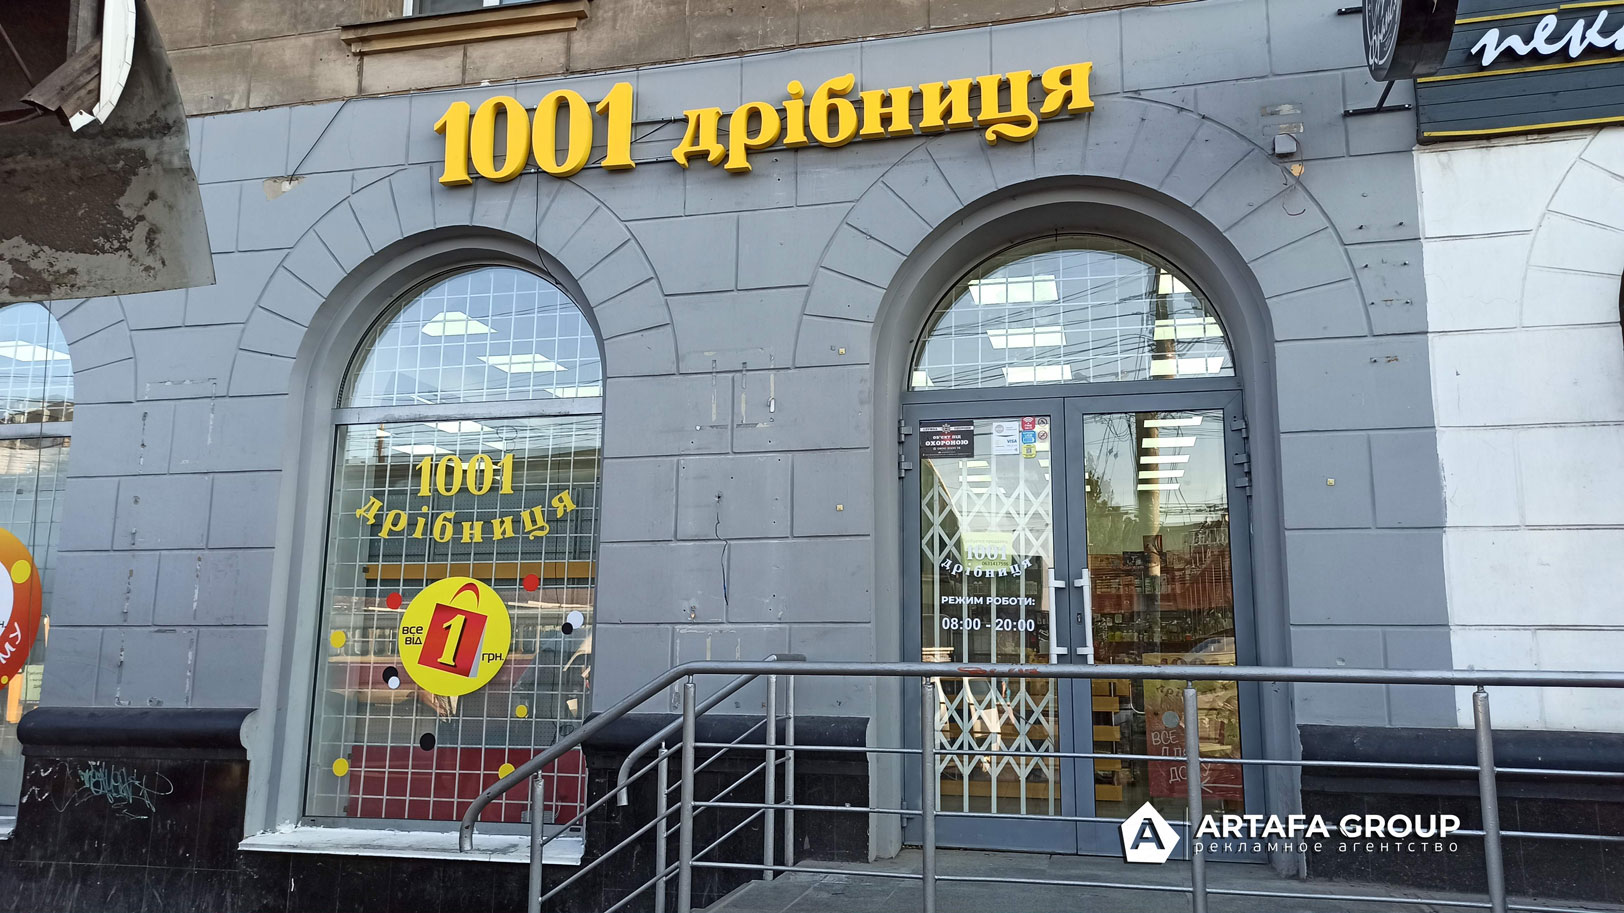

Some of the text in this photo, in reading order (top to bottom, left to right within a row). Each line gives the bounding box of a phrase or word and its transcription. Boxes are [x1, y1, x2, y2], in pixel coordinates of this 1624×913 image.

[434, 61, 1095, 186] 1001 дрібниця
[415, 453, 515, 496] 1001
[355, 489, 576, 543] дрібниця
[967, 544, 1007, 560] 1001
[941, 558, 1032, 578] дрібниця
[941, 596, 1036, 606] РЕЖИМ РОБОТИ:
[941, 617, 981, 630] 08:00
[995, 618, 1035, 631] 20:00
[1151, 730, 1179, 746] ВСЕ
